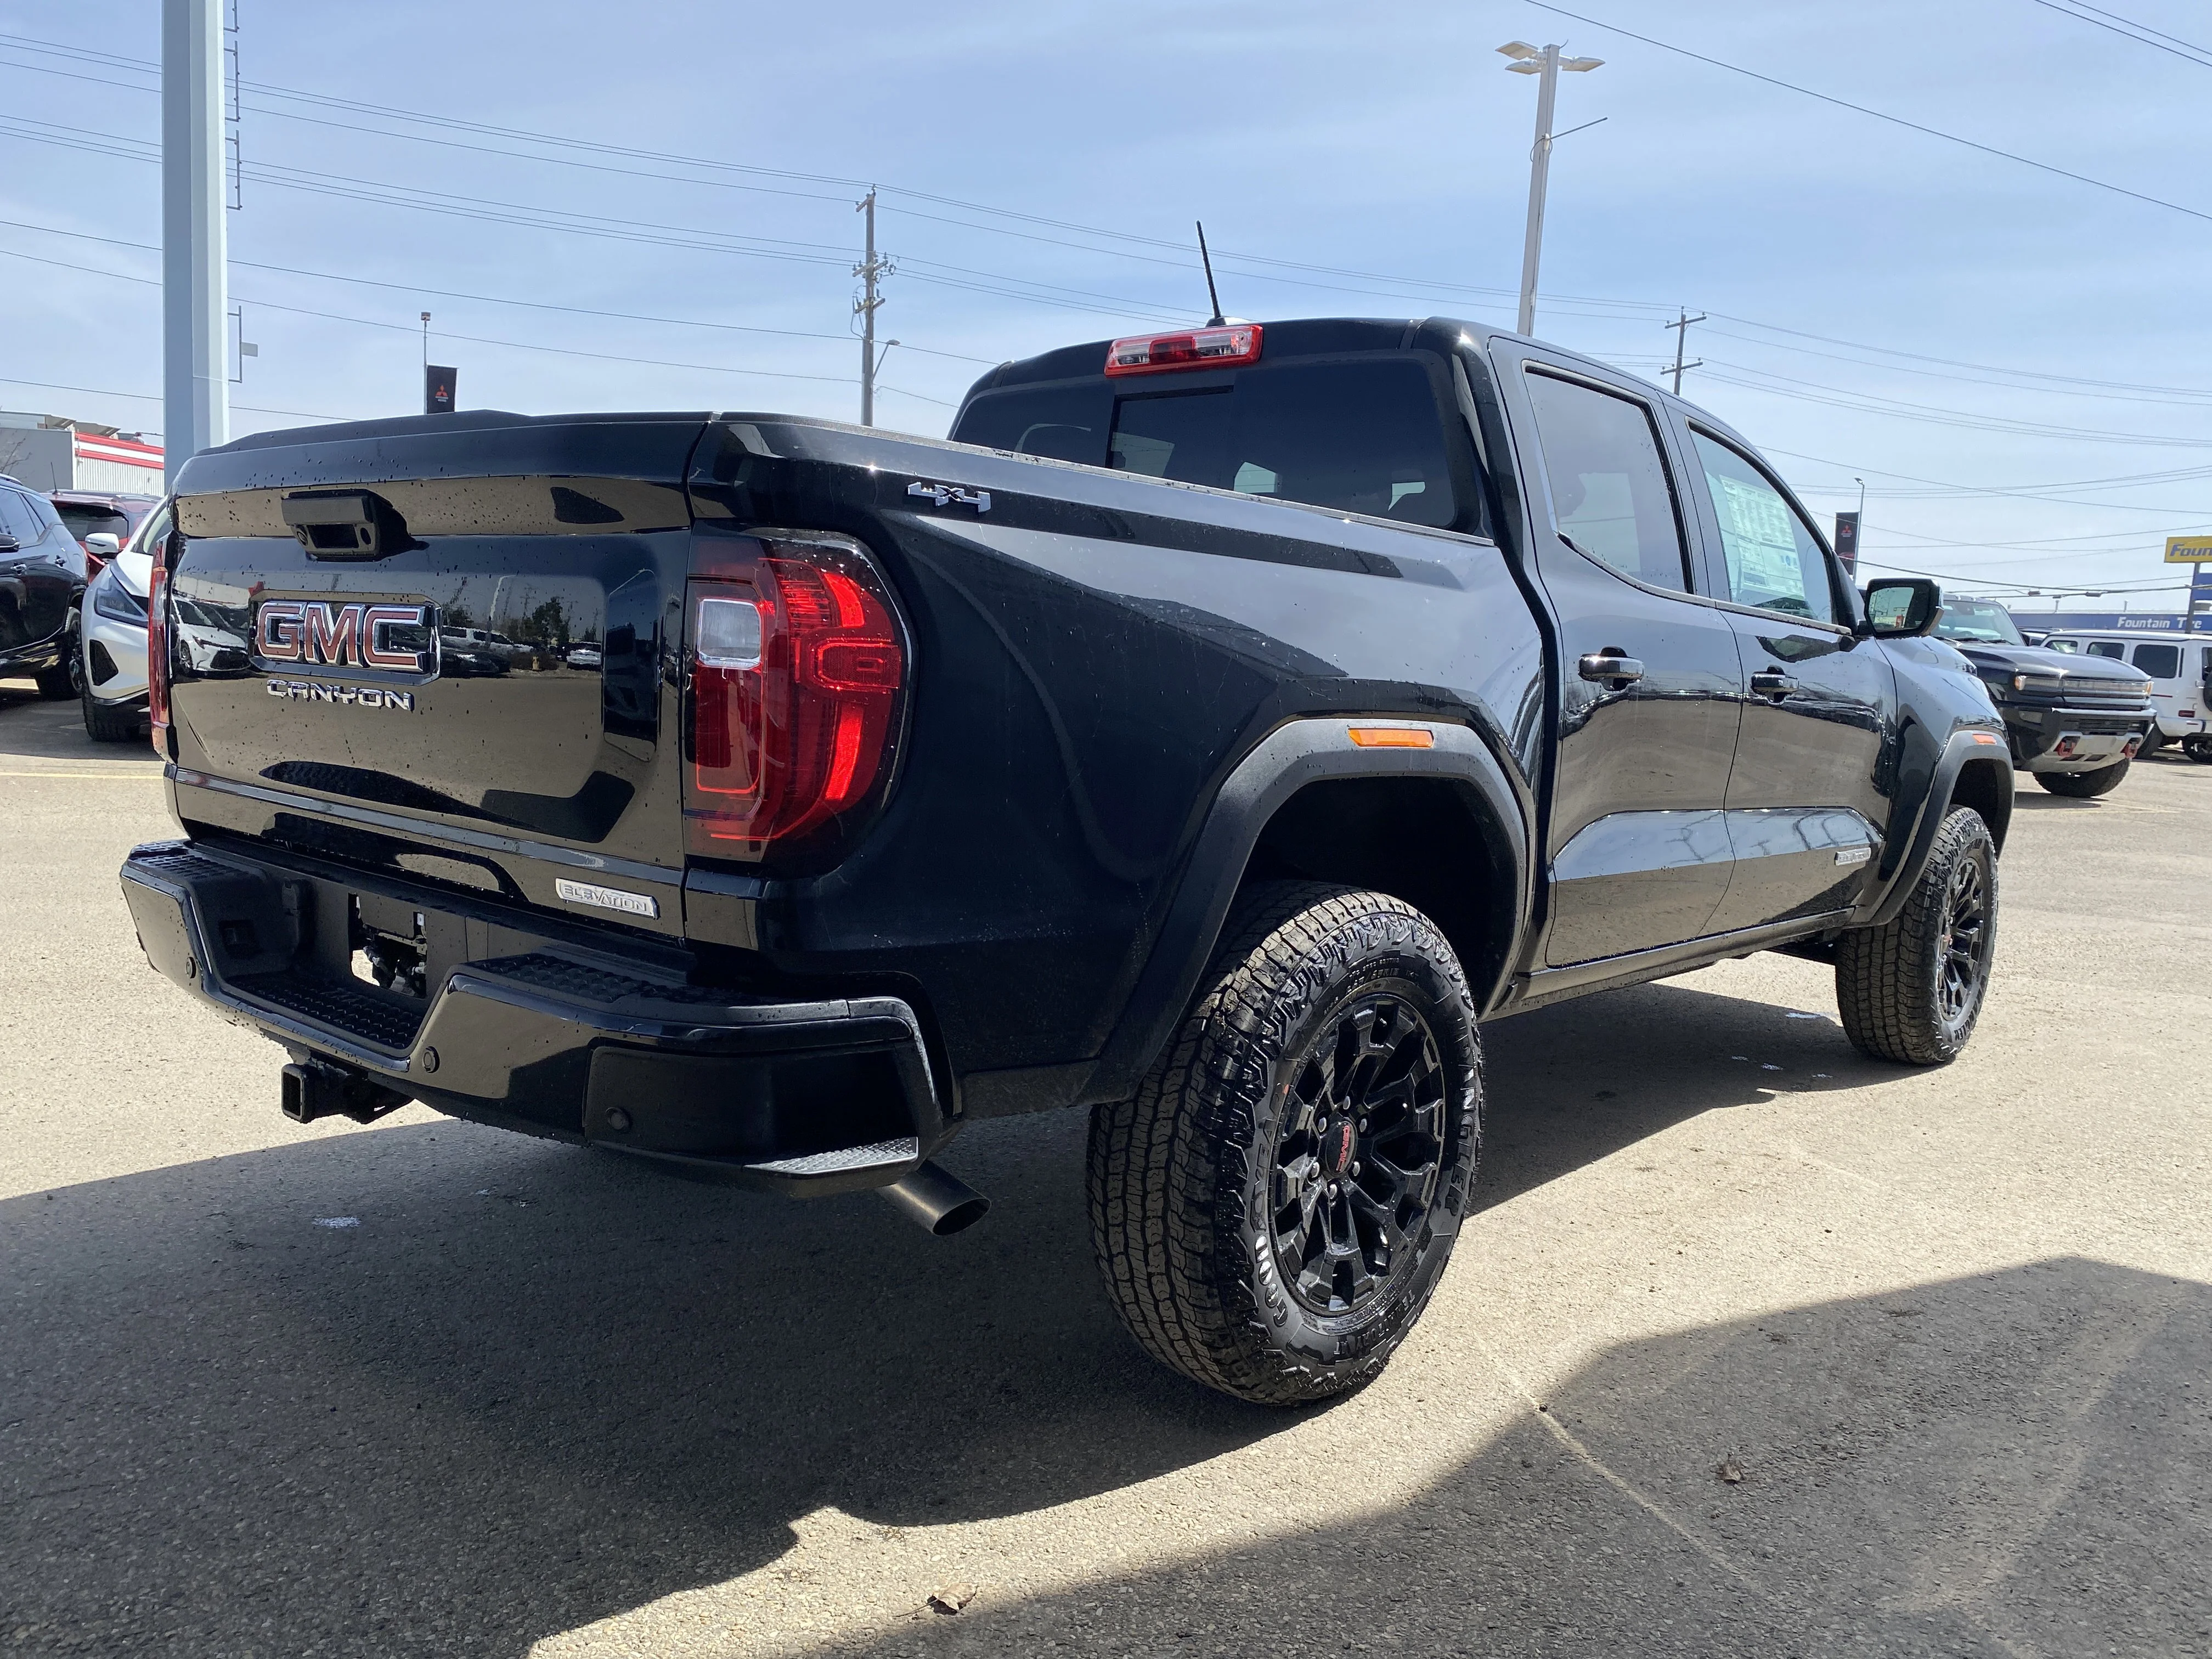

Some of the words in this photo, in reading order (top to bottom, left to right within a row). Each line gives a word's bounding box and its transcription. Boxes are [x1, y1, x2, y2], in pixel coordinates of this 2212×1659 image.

[257, 600, 426, 672] GMC
[2117, 616, 2170, 628] Fountain
[2177, 617, 2202, 629] Te
[267, 679, 415, 712] CANYON
[563, 884, 646, 912] ELEVATION
[1336, 1125, 1350, 1171] GMC
